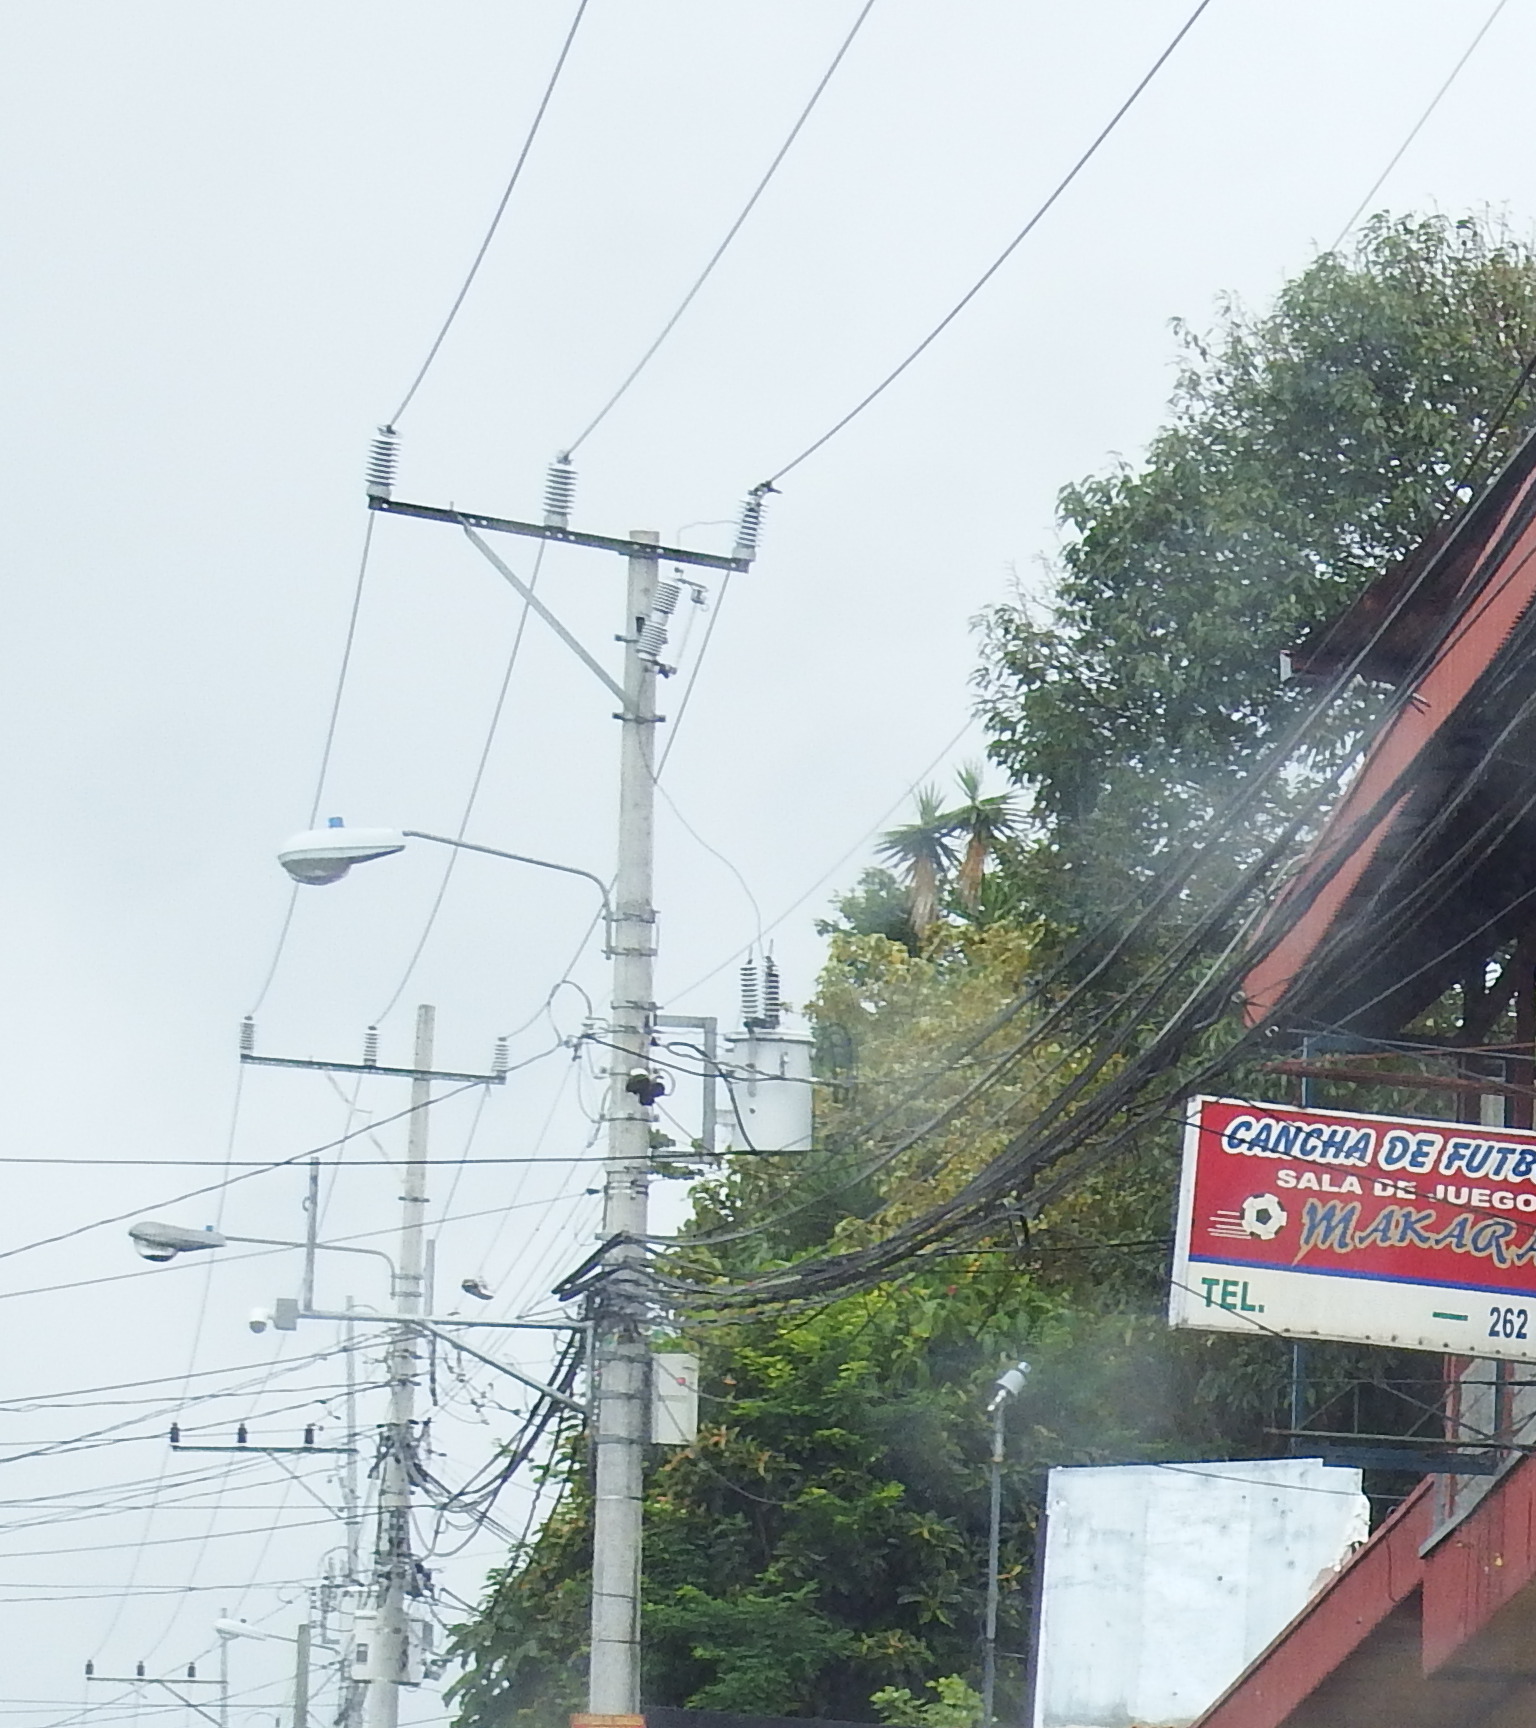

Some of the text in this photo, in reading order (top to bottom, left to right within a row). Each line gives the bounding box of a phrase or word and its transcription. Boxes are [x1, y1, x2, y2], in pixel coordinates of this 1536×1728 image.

[1224, 1117, 1374, 1166] CANCHA
[1382, 1134, 1439, 1171] DE
[1277, 1169, 1362, 1197] SALA
[1374, 1179, 1417, 1201] DE
[1201, 1277, 1266, 1313] TEL.
[1489, 1307, 1528, 1340] 262
